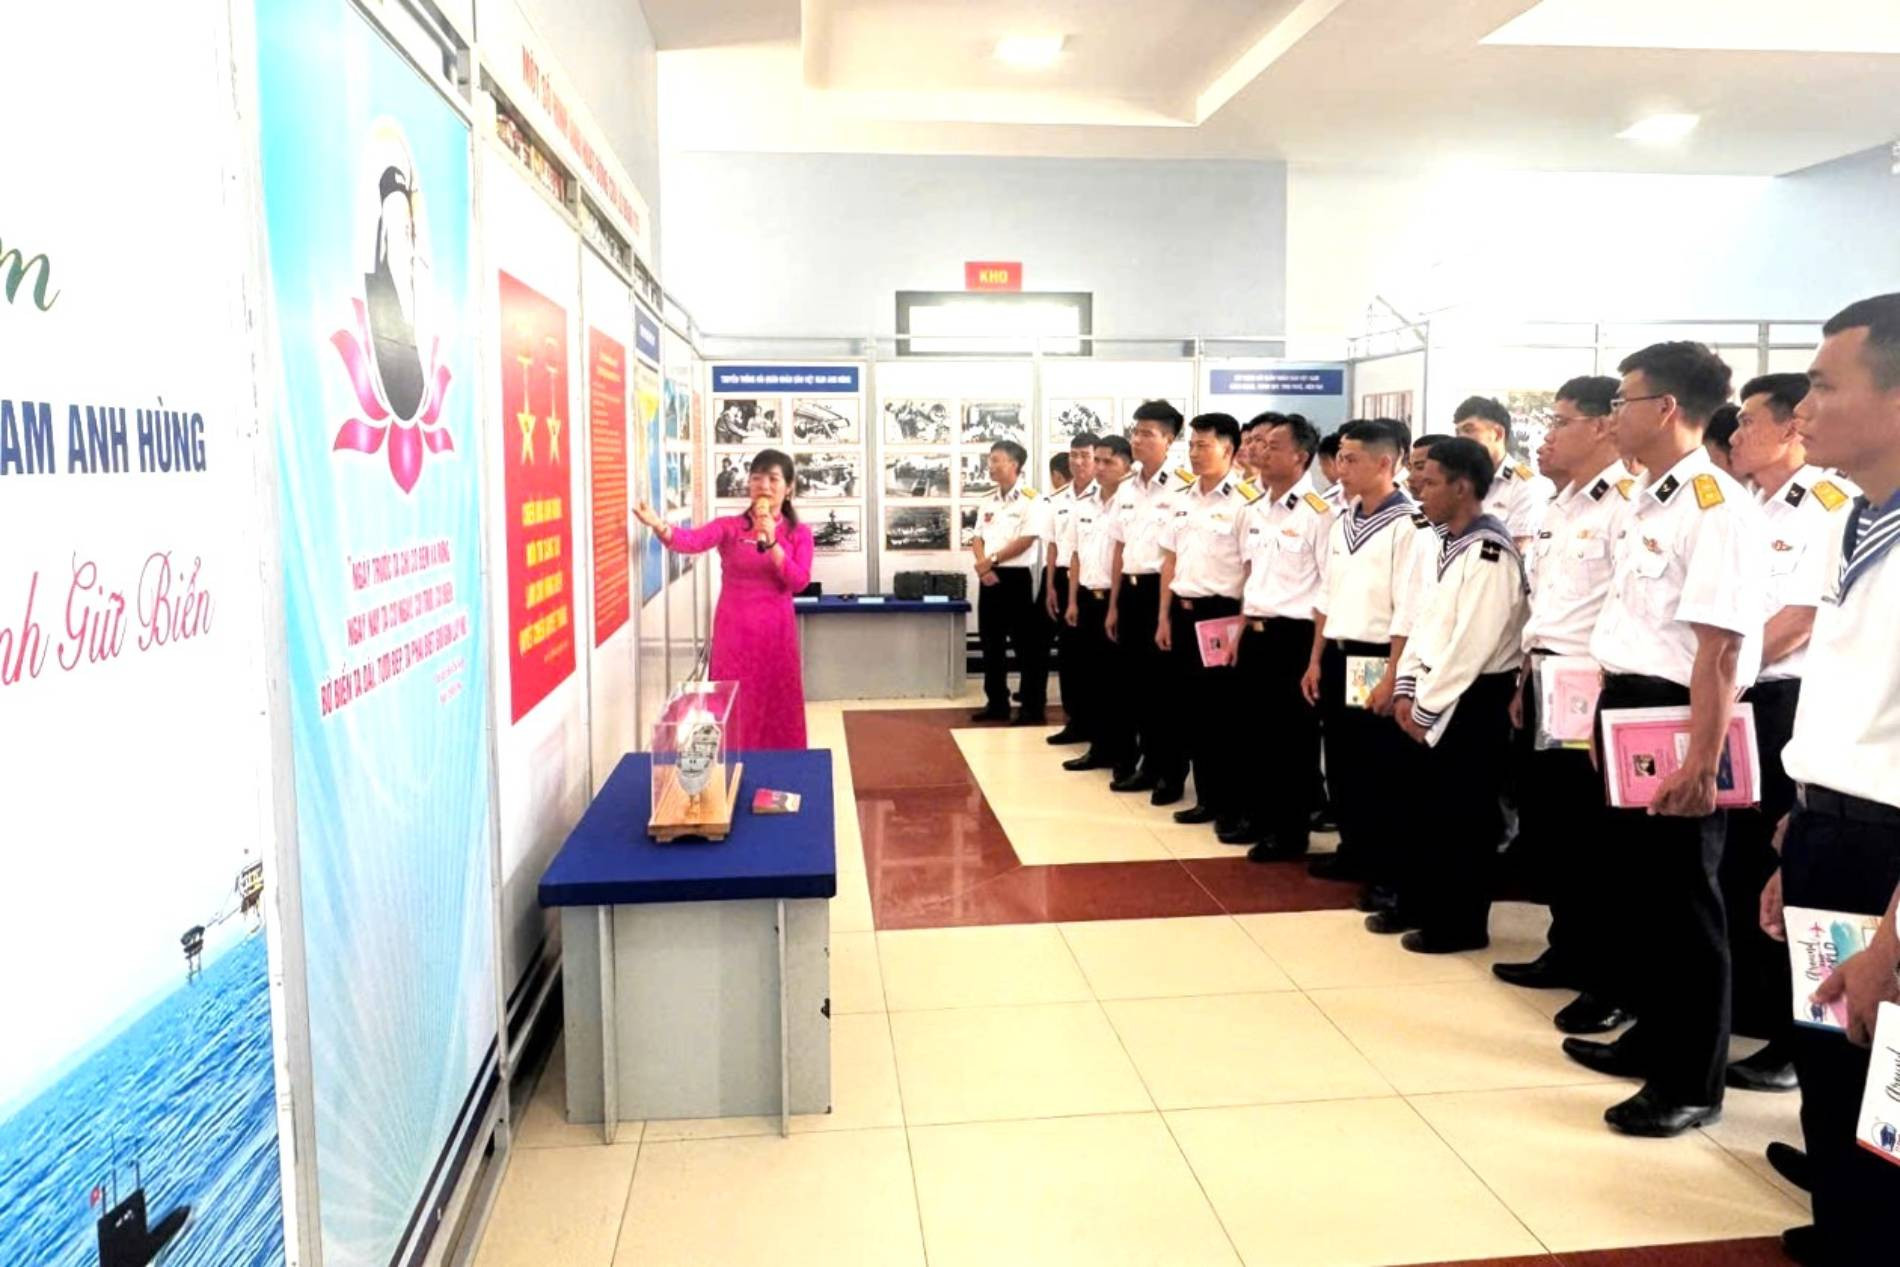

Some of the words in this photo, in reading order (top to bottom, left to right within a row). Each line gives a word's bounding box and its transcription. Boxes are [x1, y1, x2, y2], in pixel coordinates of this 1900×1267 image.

[980, 269, 1008, 283] KHO
[0, 399, 56, 475] AM
[68, 403, 129, 474] ANH
[136, 395, 207, 473] HÙNG
[57, 550, 127, 671] Giữ
[137, 550, 216, 651] Biển
[334, 660, 352, 709] BIỂN
